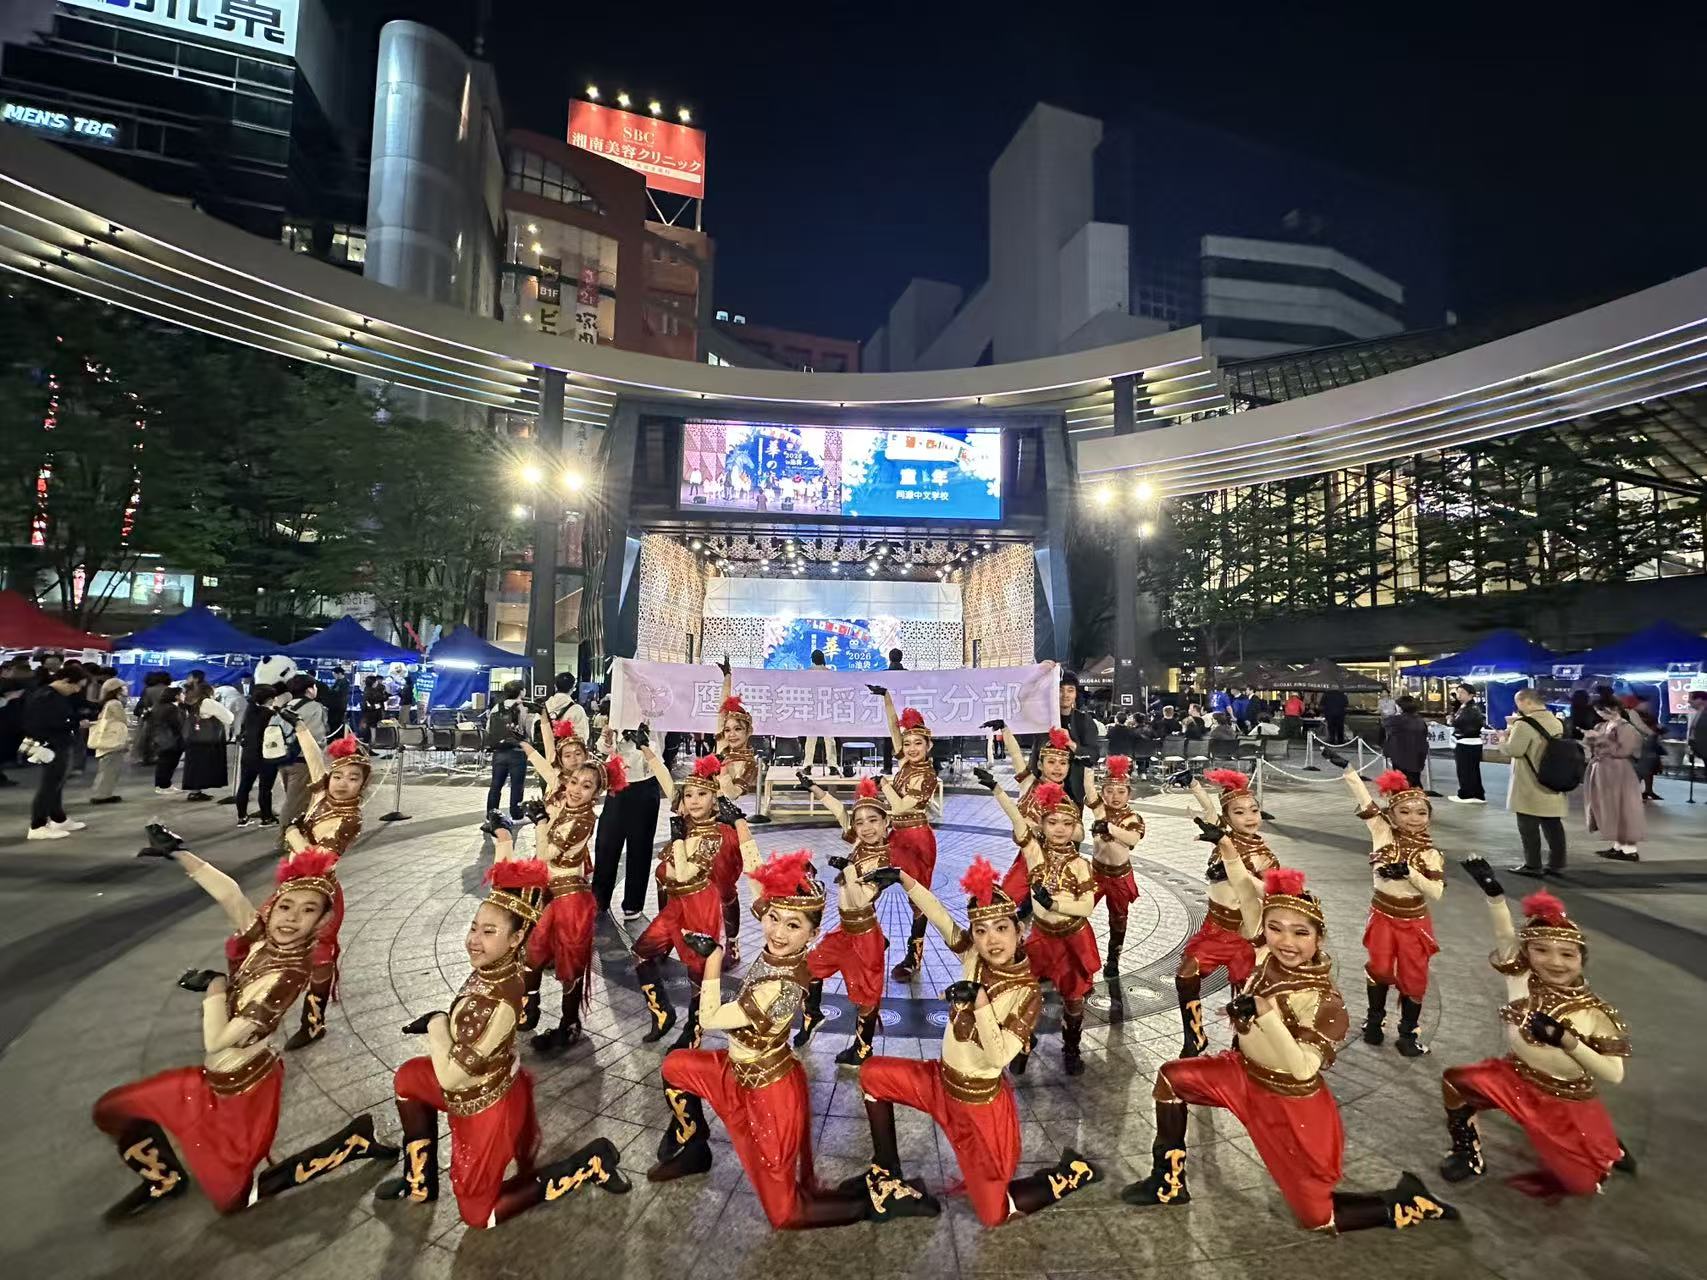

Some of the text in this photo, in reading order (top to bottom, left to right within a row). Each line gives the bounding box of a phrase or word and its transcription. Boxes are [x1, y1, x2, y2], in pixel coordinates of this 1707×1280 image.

[3, 103, 117, 139] MEN'S TBC
[622, 126, 655, 145] SBC
[571, 131, 702, 173] 湘南美容クリニック
[540, 286, 559, 298] B1F
[848, 652, 872, 660] 2026
[690, 680, 1024, 725] 鹰舞舞蹈东京分部
